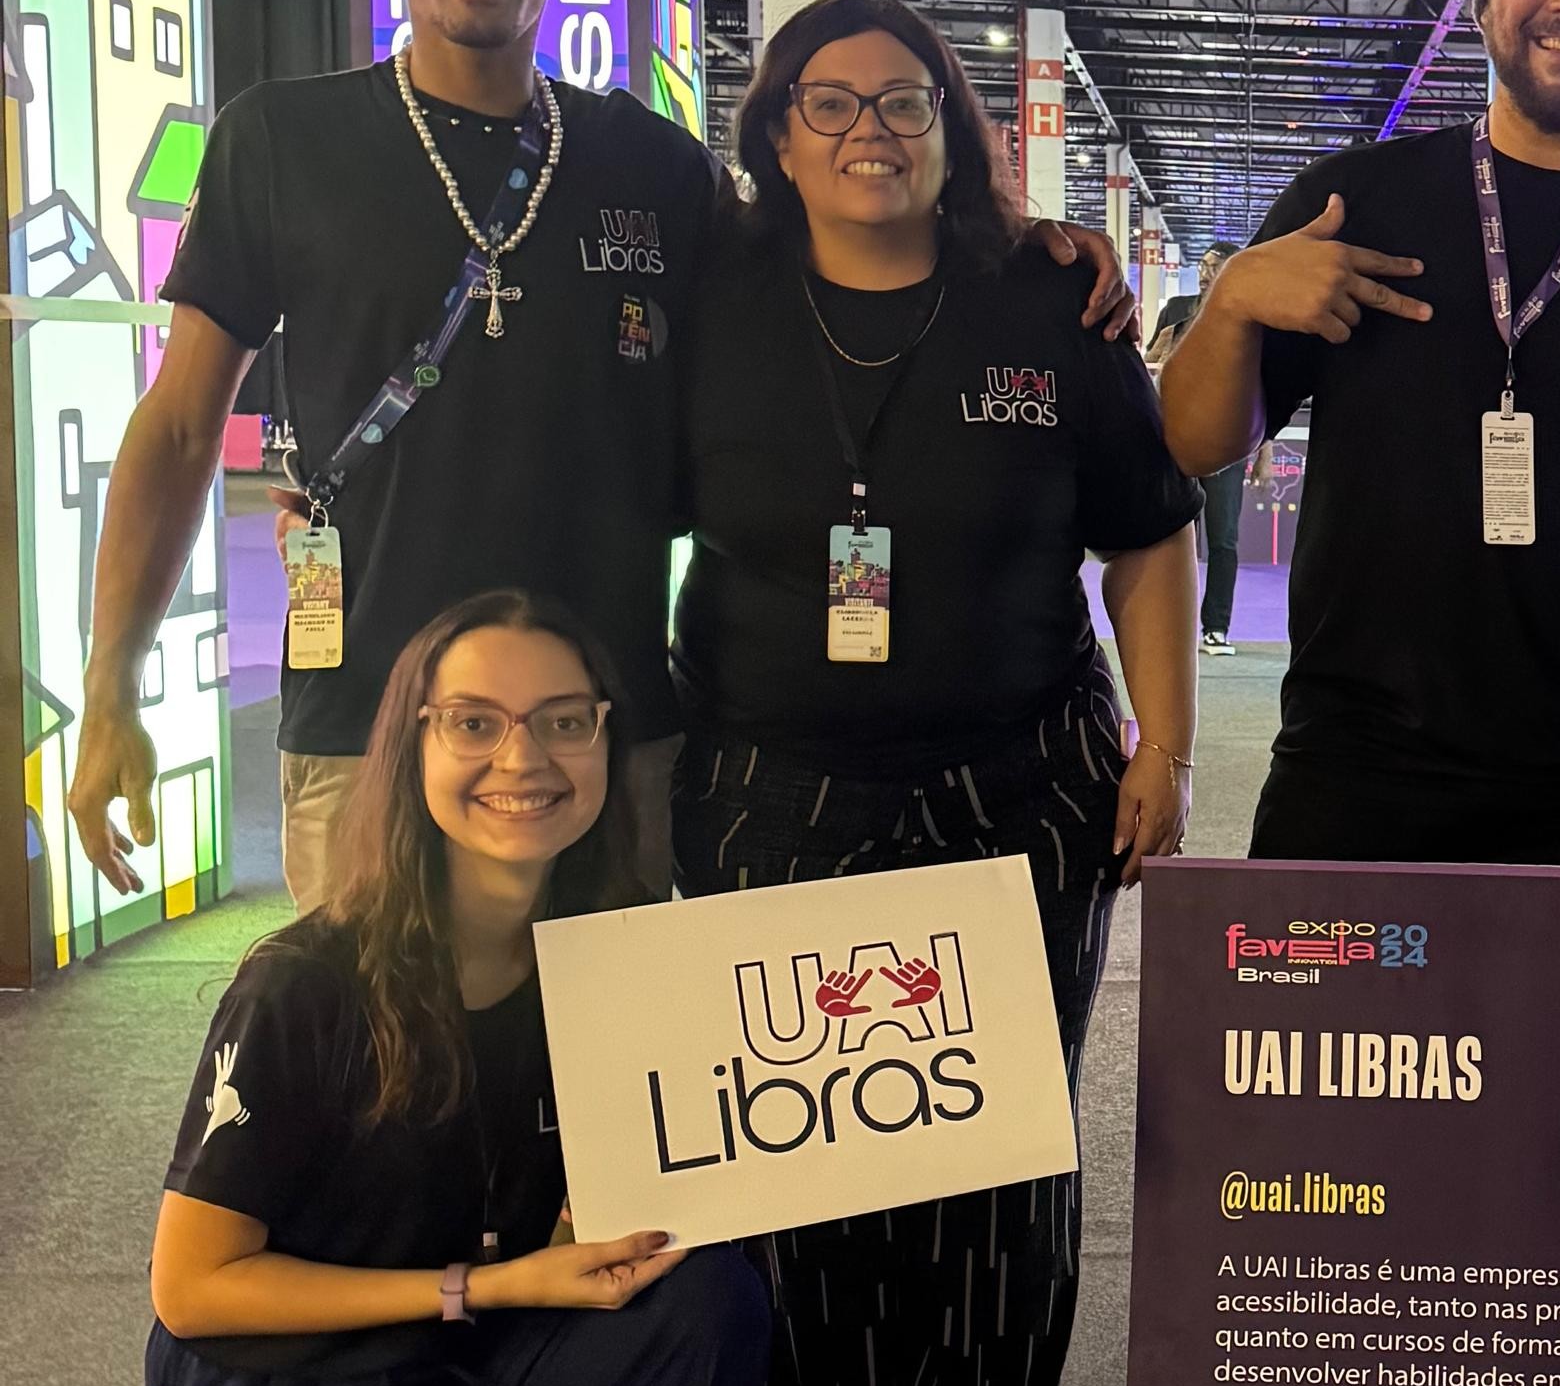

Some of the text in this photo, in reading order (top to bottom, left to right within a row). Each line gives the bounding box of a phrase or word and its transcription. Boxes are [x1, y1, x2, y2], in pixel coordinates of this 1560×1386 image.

[1033, 104, 1058, 134] H
[601, 209, 660, 247] UAI
[579, 237, 665, 274] Libras
[987, 367, 1056, 402] UAI
[960, 393, 1058, 427] Libras
[1287, 919, 1376, 939] expo
[1379, 923, 1429, 947] 20
[1379, 944, 1429, 968] 24
[1237, 967, 1321, 984] Brasil
[734, 931, 974, 1066] UAI
[1224, 1029, 1482, 1101] UAI LIBRAS
[647, 1047, 985, 1174] Libras
[1220, 1170, 1386, 1220] @uai.libras
[1217, 1255, 1237, 1277] A
[1244, 1255, 1287, 1278] UAI
[1295, 1255, 1370, 1281] Libras
[1377, 1258, 1393, 1281] é
[1400, 1265, 1456, 1283] uma
[1216, 1290, 1401, 1319] acessibilidade,
[1408, 1296, 1477, 1318] tanto
[1485, 1302, 1528, 1320] nas
[1215, 1327, 1309, 1353] quanto
[1315, 1332, 1355, 1350] em
[1362, 1334, 1445, 1353] cursos
[1452, 1329, 1485, 1354] de
[1214, 1358, 1372, 1385] desenvolver
